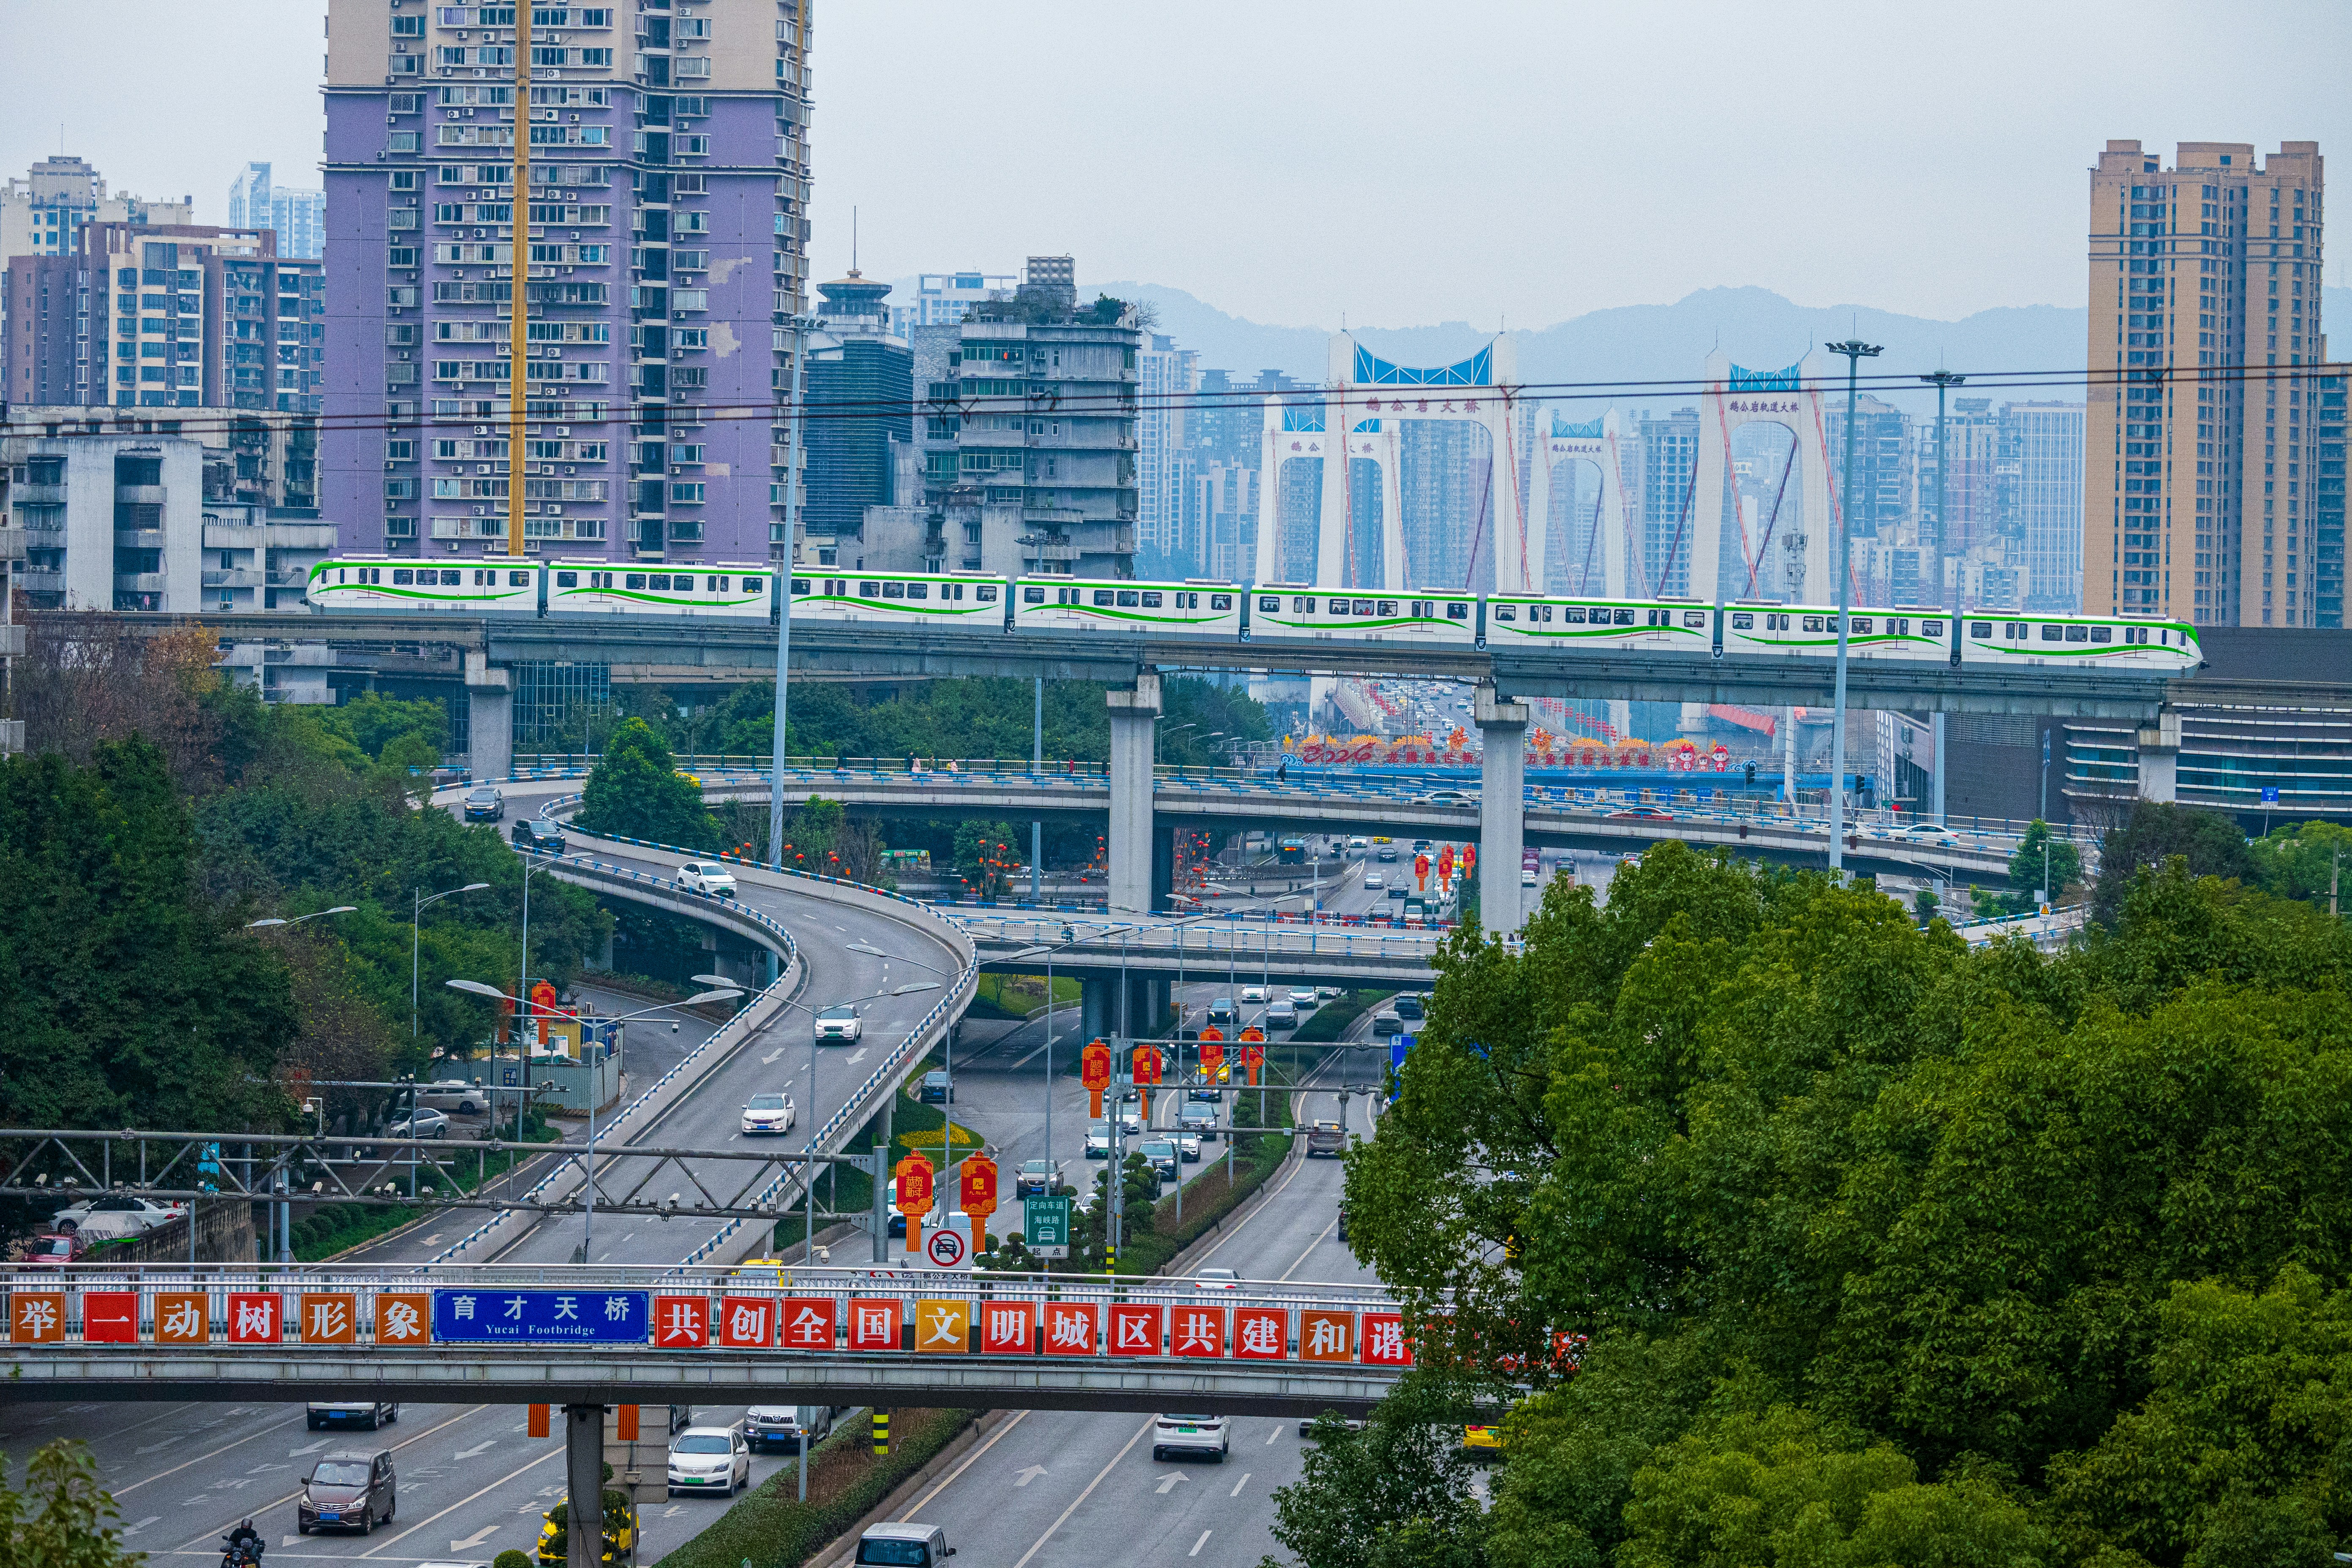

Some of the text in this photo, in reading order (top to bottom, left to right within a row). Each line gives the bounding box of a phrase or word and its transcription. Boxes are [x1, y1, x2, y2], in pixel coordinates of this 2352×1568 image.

[1730, 401, 1799, 412] 鹅公岩轨道大桥
[1291, 441, 1374, 454] 鹅公桥
[1303, 742, 1377, 764] 2026
[1386, 751, 1483, 765] 龙腾盛世新
[1030, 1201, 1064, 1210] 定向车道
[1034, 1216, 1059, 1224] 海峡路
[1032, 1247, 1061, 1256] 起点
[452, 1295, 629, 1321] 育才天桥
[486, 1325, 595, 1337] Yucai Footbridge
